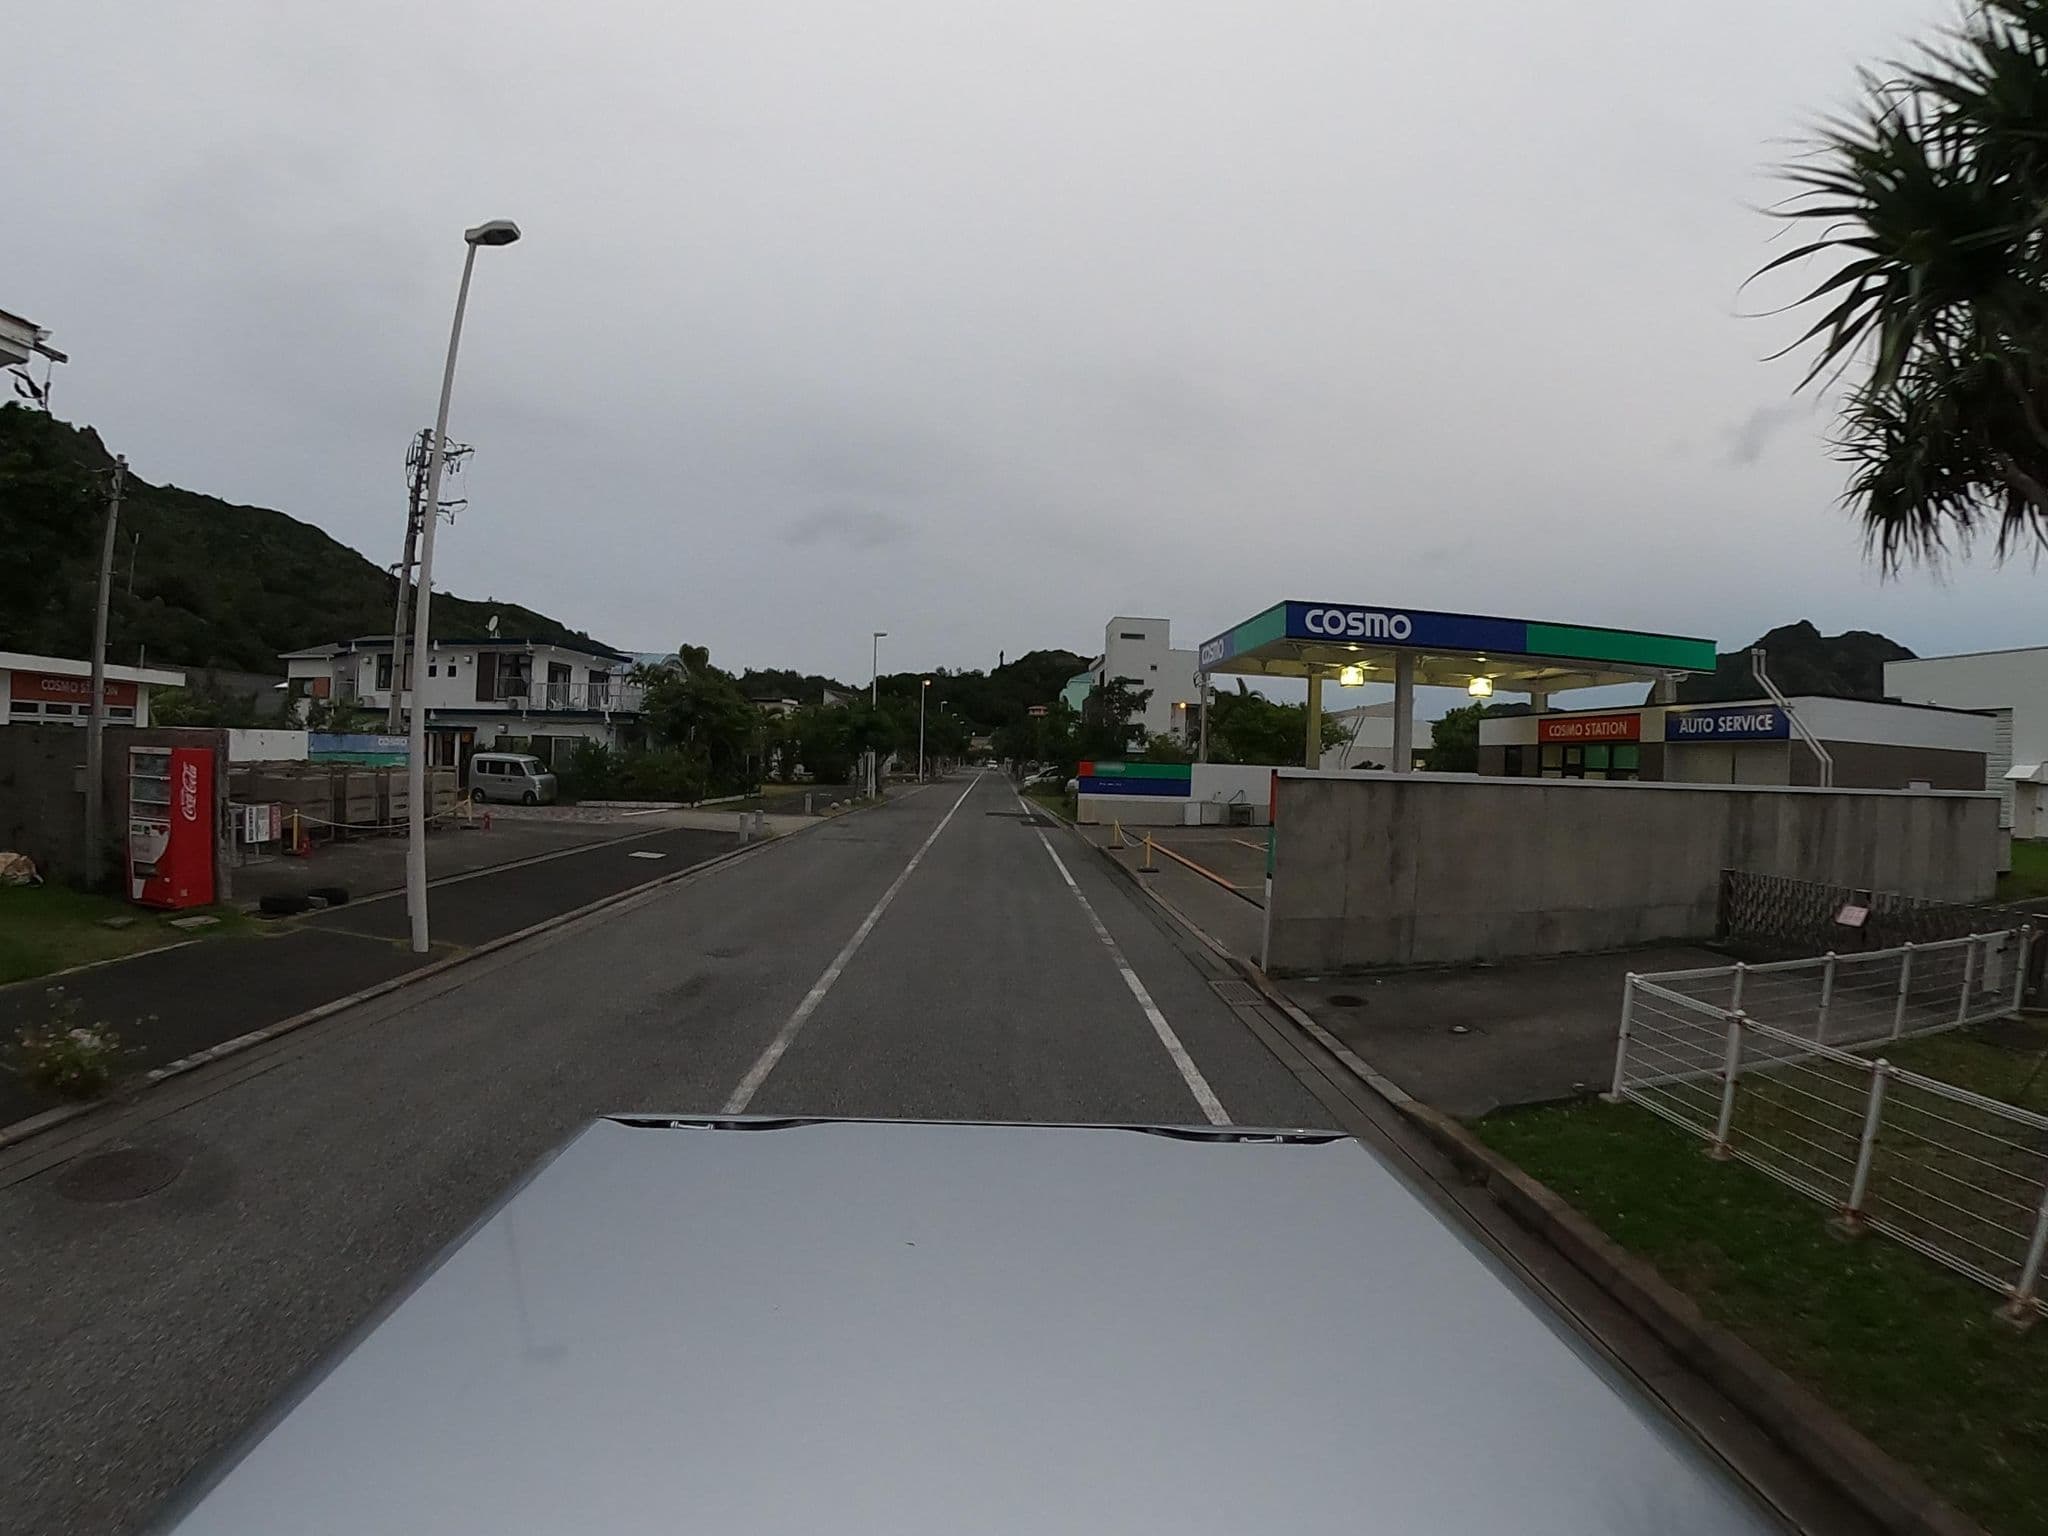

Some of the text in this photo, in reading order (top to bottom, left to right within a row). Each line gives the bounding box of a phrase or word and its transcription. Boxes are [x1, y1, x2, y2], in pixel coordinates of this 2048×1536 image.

[1305, 609, 1412, 640] COSMO
[1201, 638, 1224, 665] COSMO
[41, 679, 78, 693] COSMO
[1549, 721, 1628, 737] COSMO STATION
[1679, 714, 1773, 734] AUTO SERVICE
